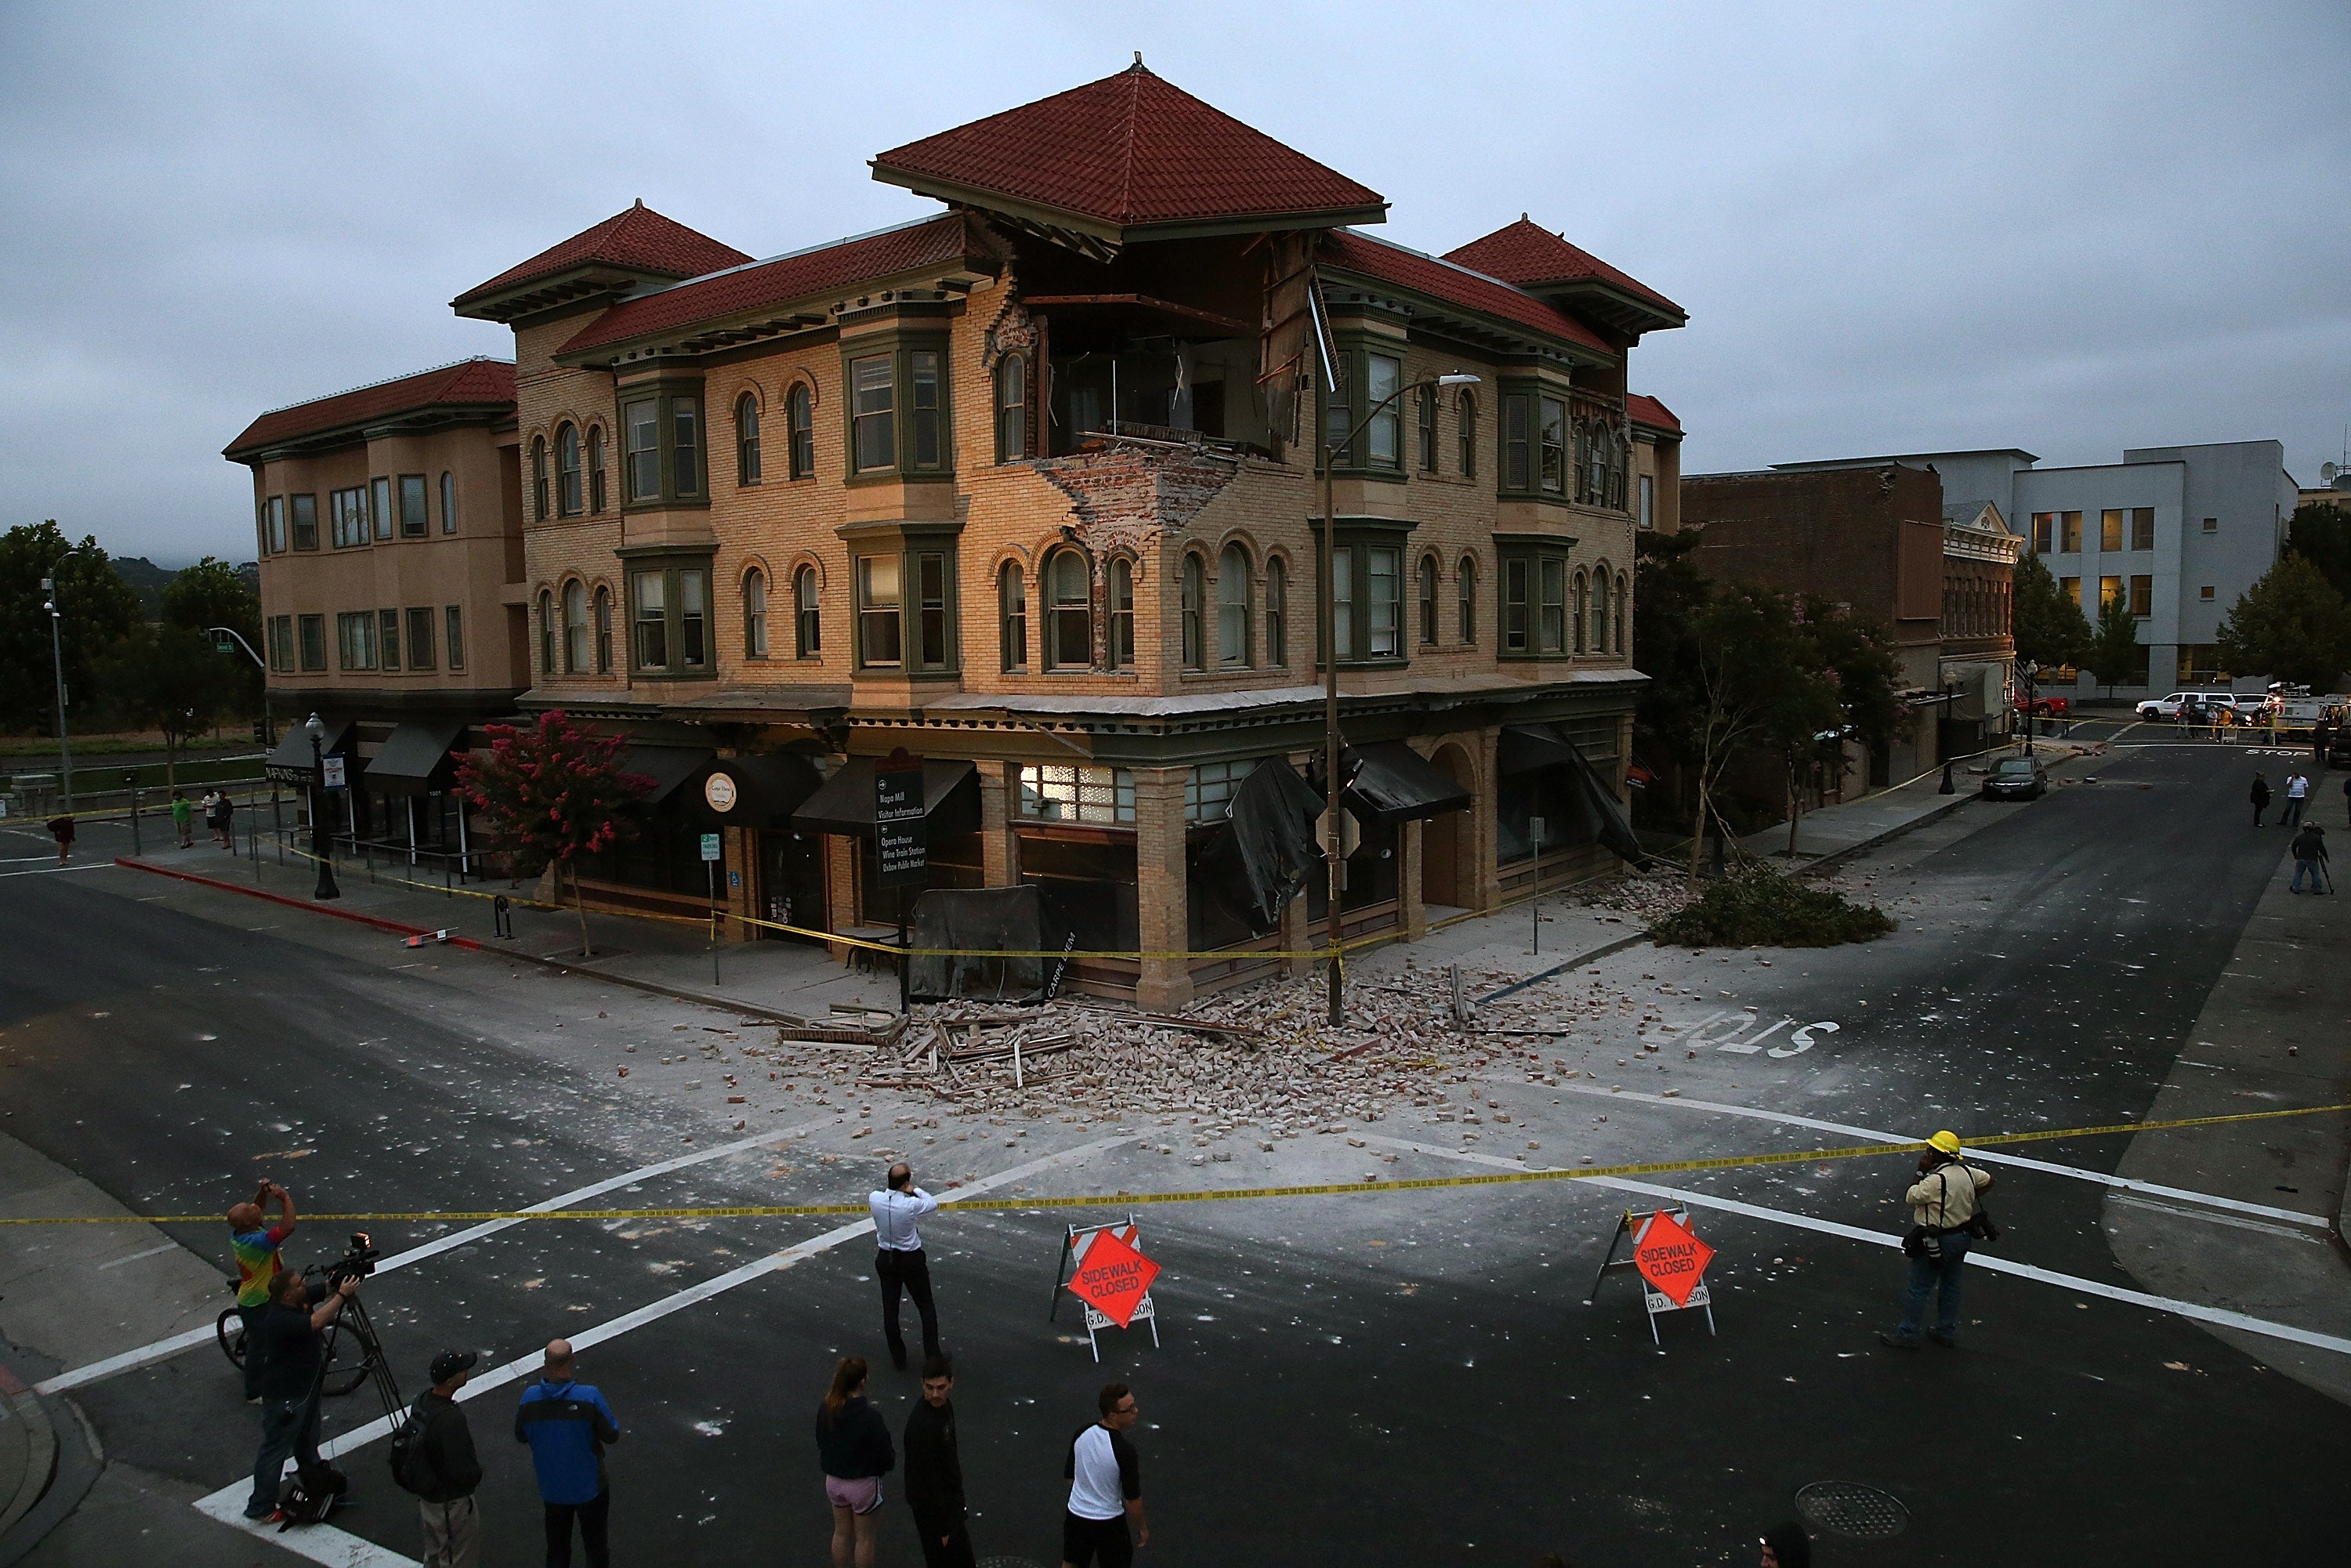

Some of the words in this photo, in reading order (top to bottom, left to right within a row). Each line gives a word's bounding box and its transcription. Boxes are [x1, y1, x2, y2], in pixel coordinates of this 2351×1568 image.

[880, 794, 893, 804] Napa
[895, 791, 904, 801] Mill
[878, 810, 893, 819] Visitor
[894, 807, 923, 817] Information
[882, 838, 897, 847] Opera
[882, 850, 895, 859] Wine
[896, 849, 907, 857] Train
[909, 846, 925, 856] Station
[882, 863, 897, 872] Oxbow
[898, 860, 909, 870] Public
[911, 858, 925, 867] Market
[1048, 961, 1064, 998] CARPE
[1641, 1243, 1697, 1263] SIDEWALK
[1081, 1259, 1143, 1285] SIDEWALK
[1650, 1258, 1695, 1277] CLOSED
[1091, 1276, 1139, 1298] CLOSED
[1648, 1298, 1666, 1309] G.D.
[1087, 1313, 1107, 1326] G.D.
